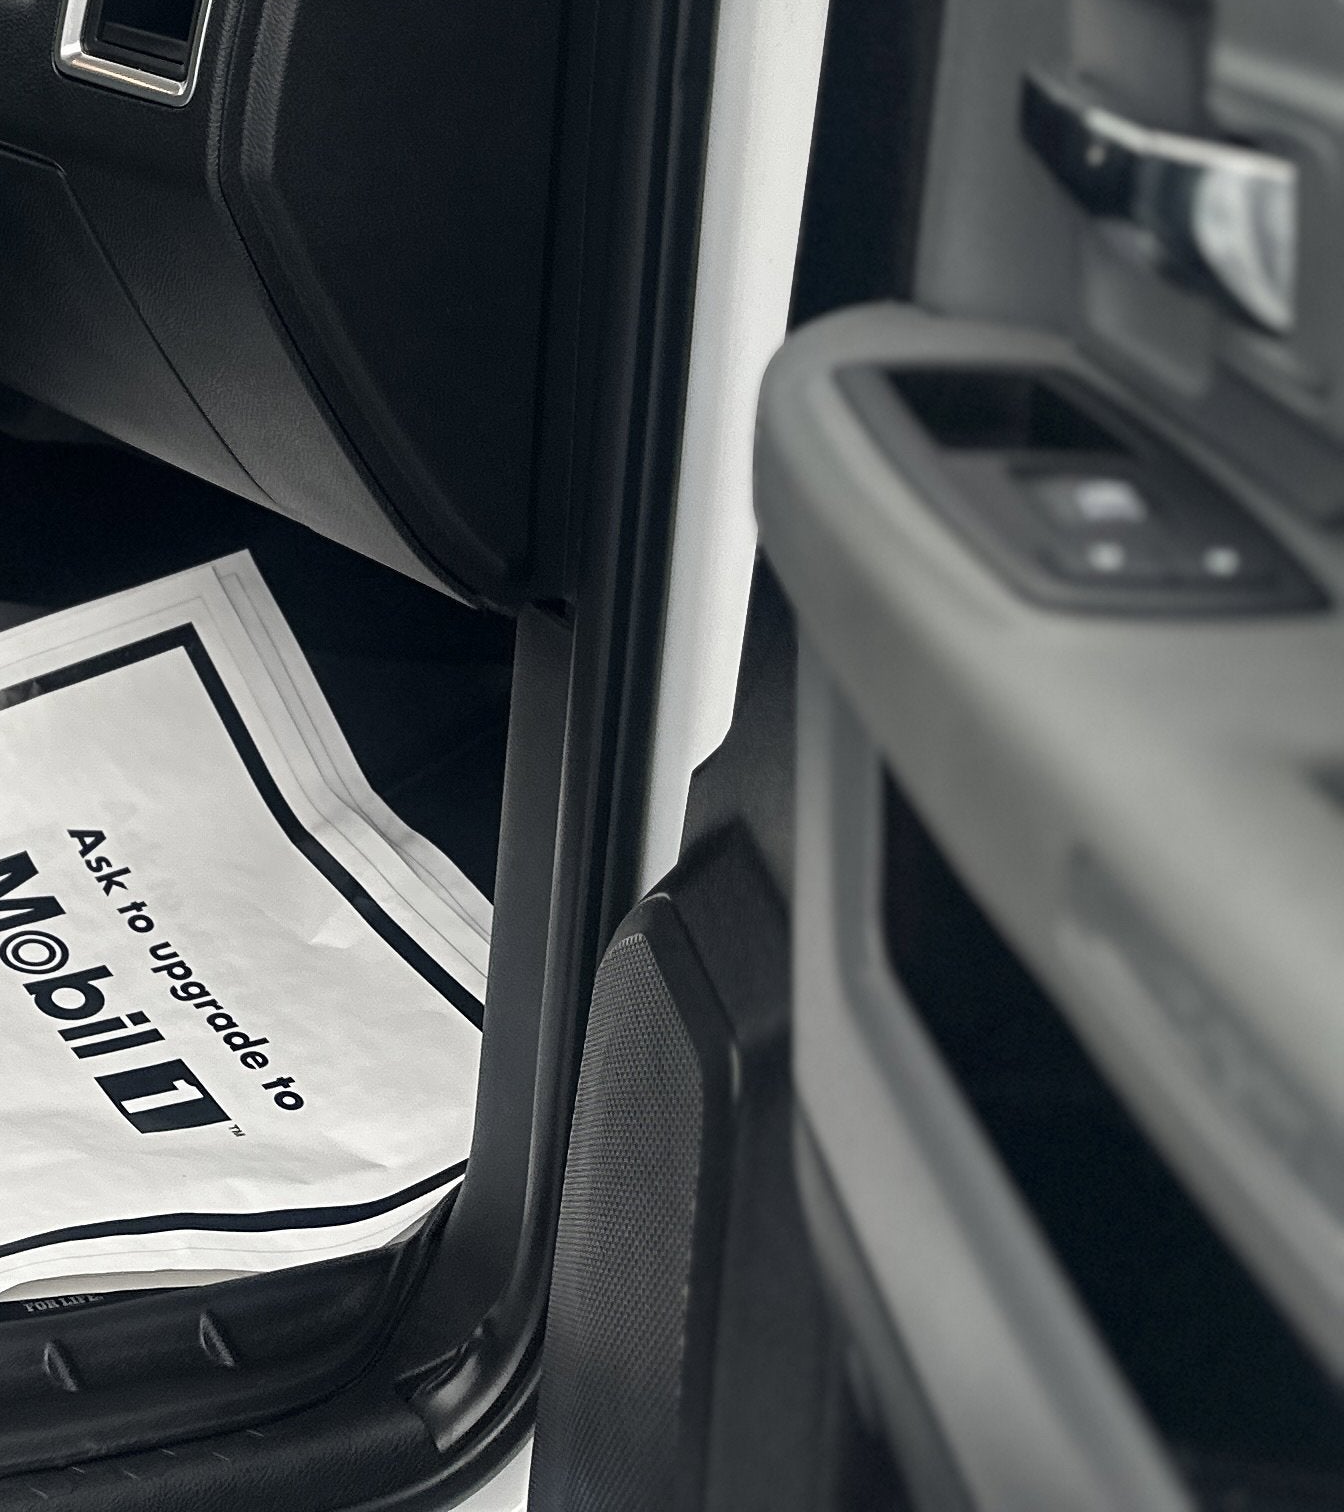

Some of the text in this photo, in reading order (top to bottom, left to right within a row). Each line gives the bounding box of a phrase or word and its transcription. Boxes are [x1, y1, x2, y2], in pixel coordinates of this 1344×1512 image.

[67, 829, 305, 1111] Ask to upgrade to
[23, 1300, 60, 1313] FOR
